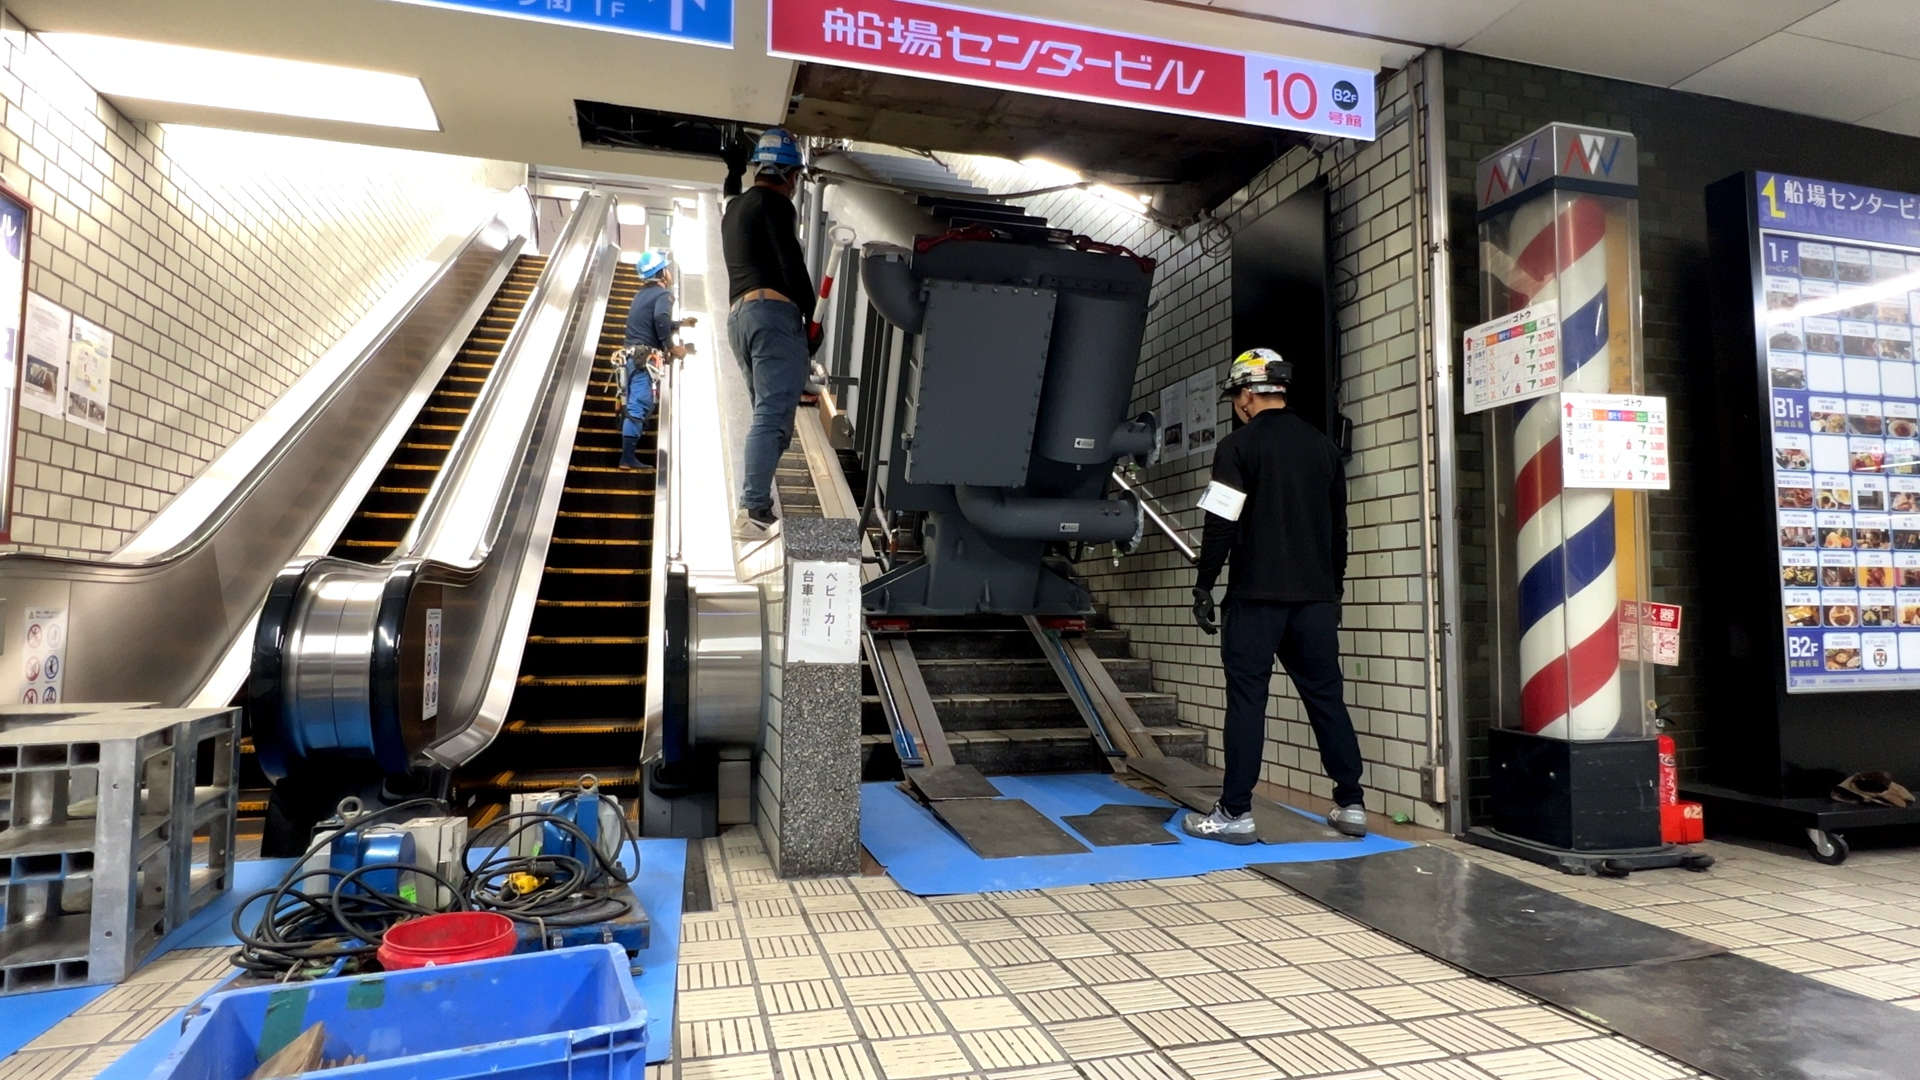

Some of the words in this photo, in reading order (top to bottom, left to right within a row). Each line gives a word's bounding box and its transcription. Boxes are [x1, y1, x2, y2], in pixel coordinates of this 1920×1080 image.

[821, 7, 1206, 96] 船場センタービル
[1263, 69, 1318, 120] 10
[1333, 88, 1357, 104] B2F
[1328, 111, 1362, 128] 号館
[1783, 179, 1920, 220] 船場センタービ
[1769, 242, 1789, 263] 1F
[1512, 310, 1531, 323] ゴトウ
[1538, 330, 1555, 342] 2,700
[1538, 345, 1555, 357] 3,300
[1623, 398, 1643, 407] ゴトウ
[1774, 397, 1804, 419] B1F
[1624, 603, 1675, 622] 消火器
[1788, 636, 1819, 658] B2F
